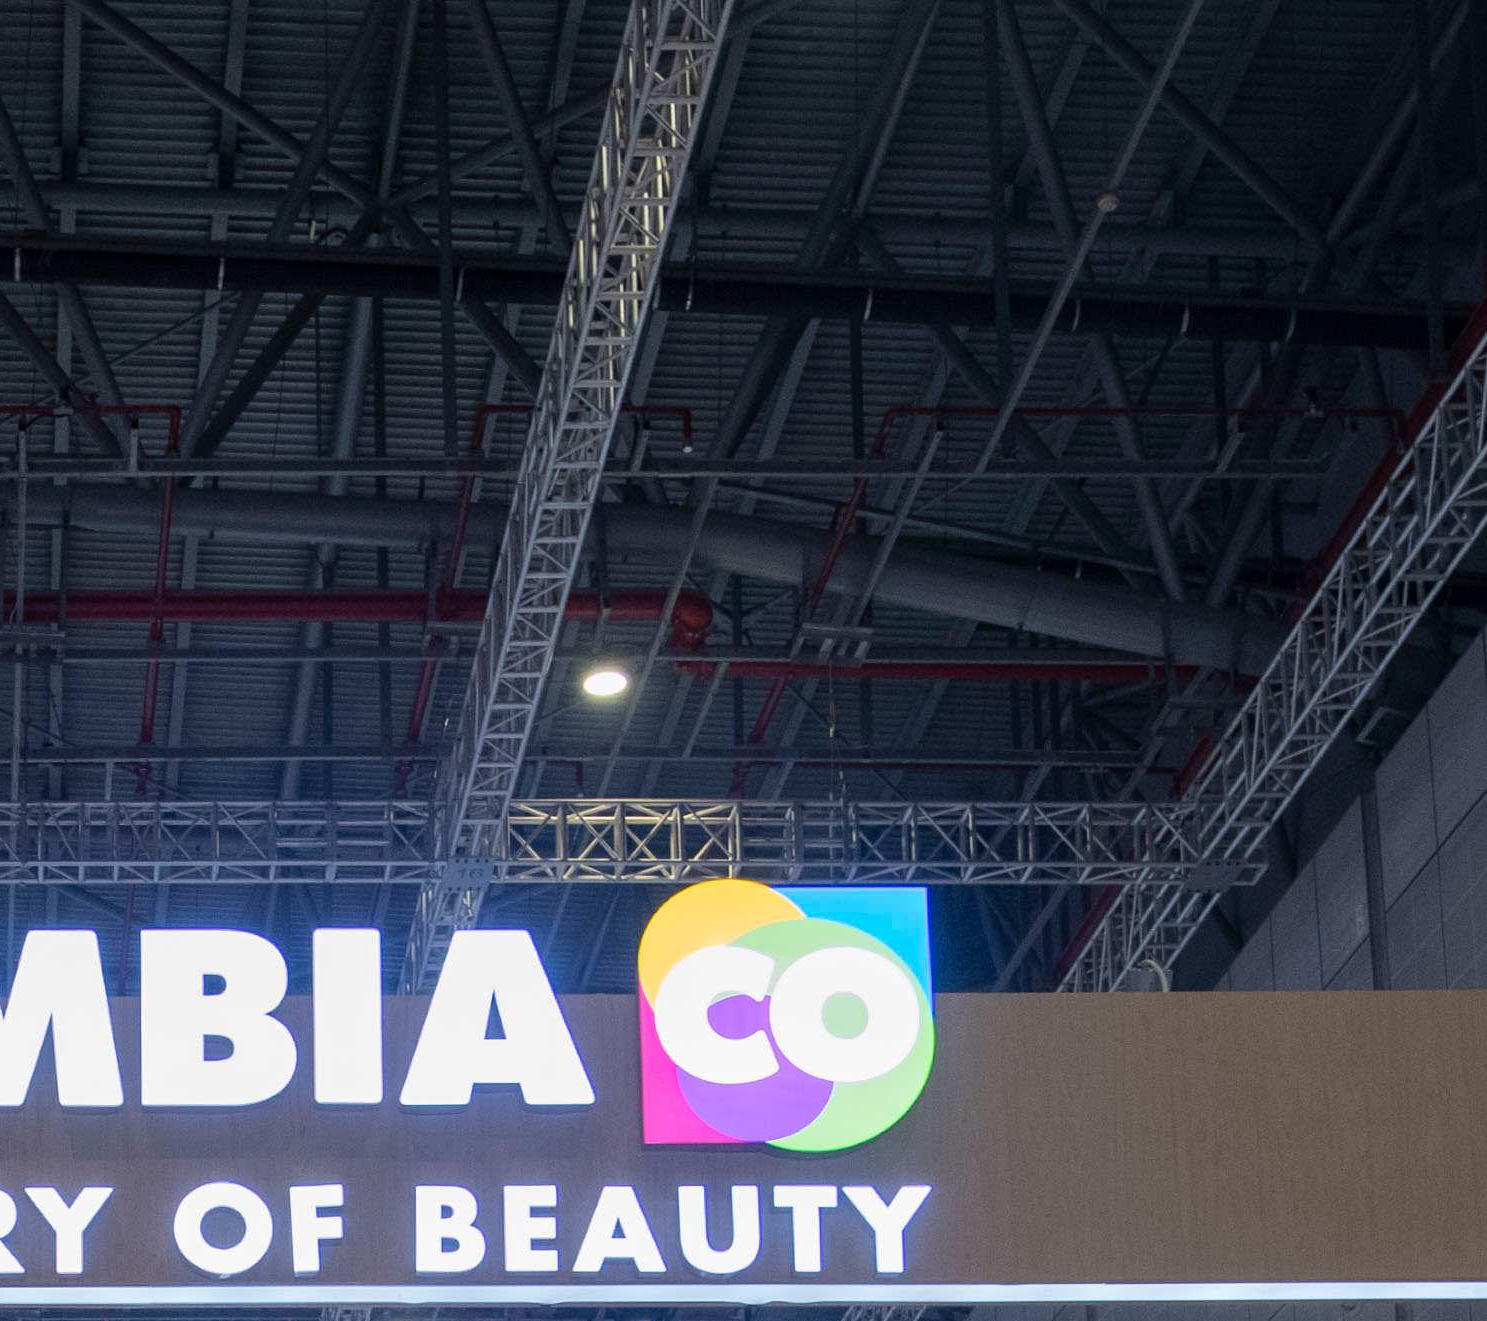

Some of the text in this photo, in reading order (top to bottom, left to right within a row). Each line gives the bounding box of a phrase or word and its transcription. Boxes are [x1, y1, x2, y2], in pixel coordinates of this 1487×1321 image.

[652, 944, 921, 1085] CO
[172, 1183, 345, 1275] OF
[414, 1184, 932, 1274] BEAUTY
